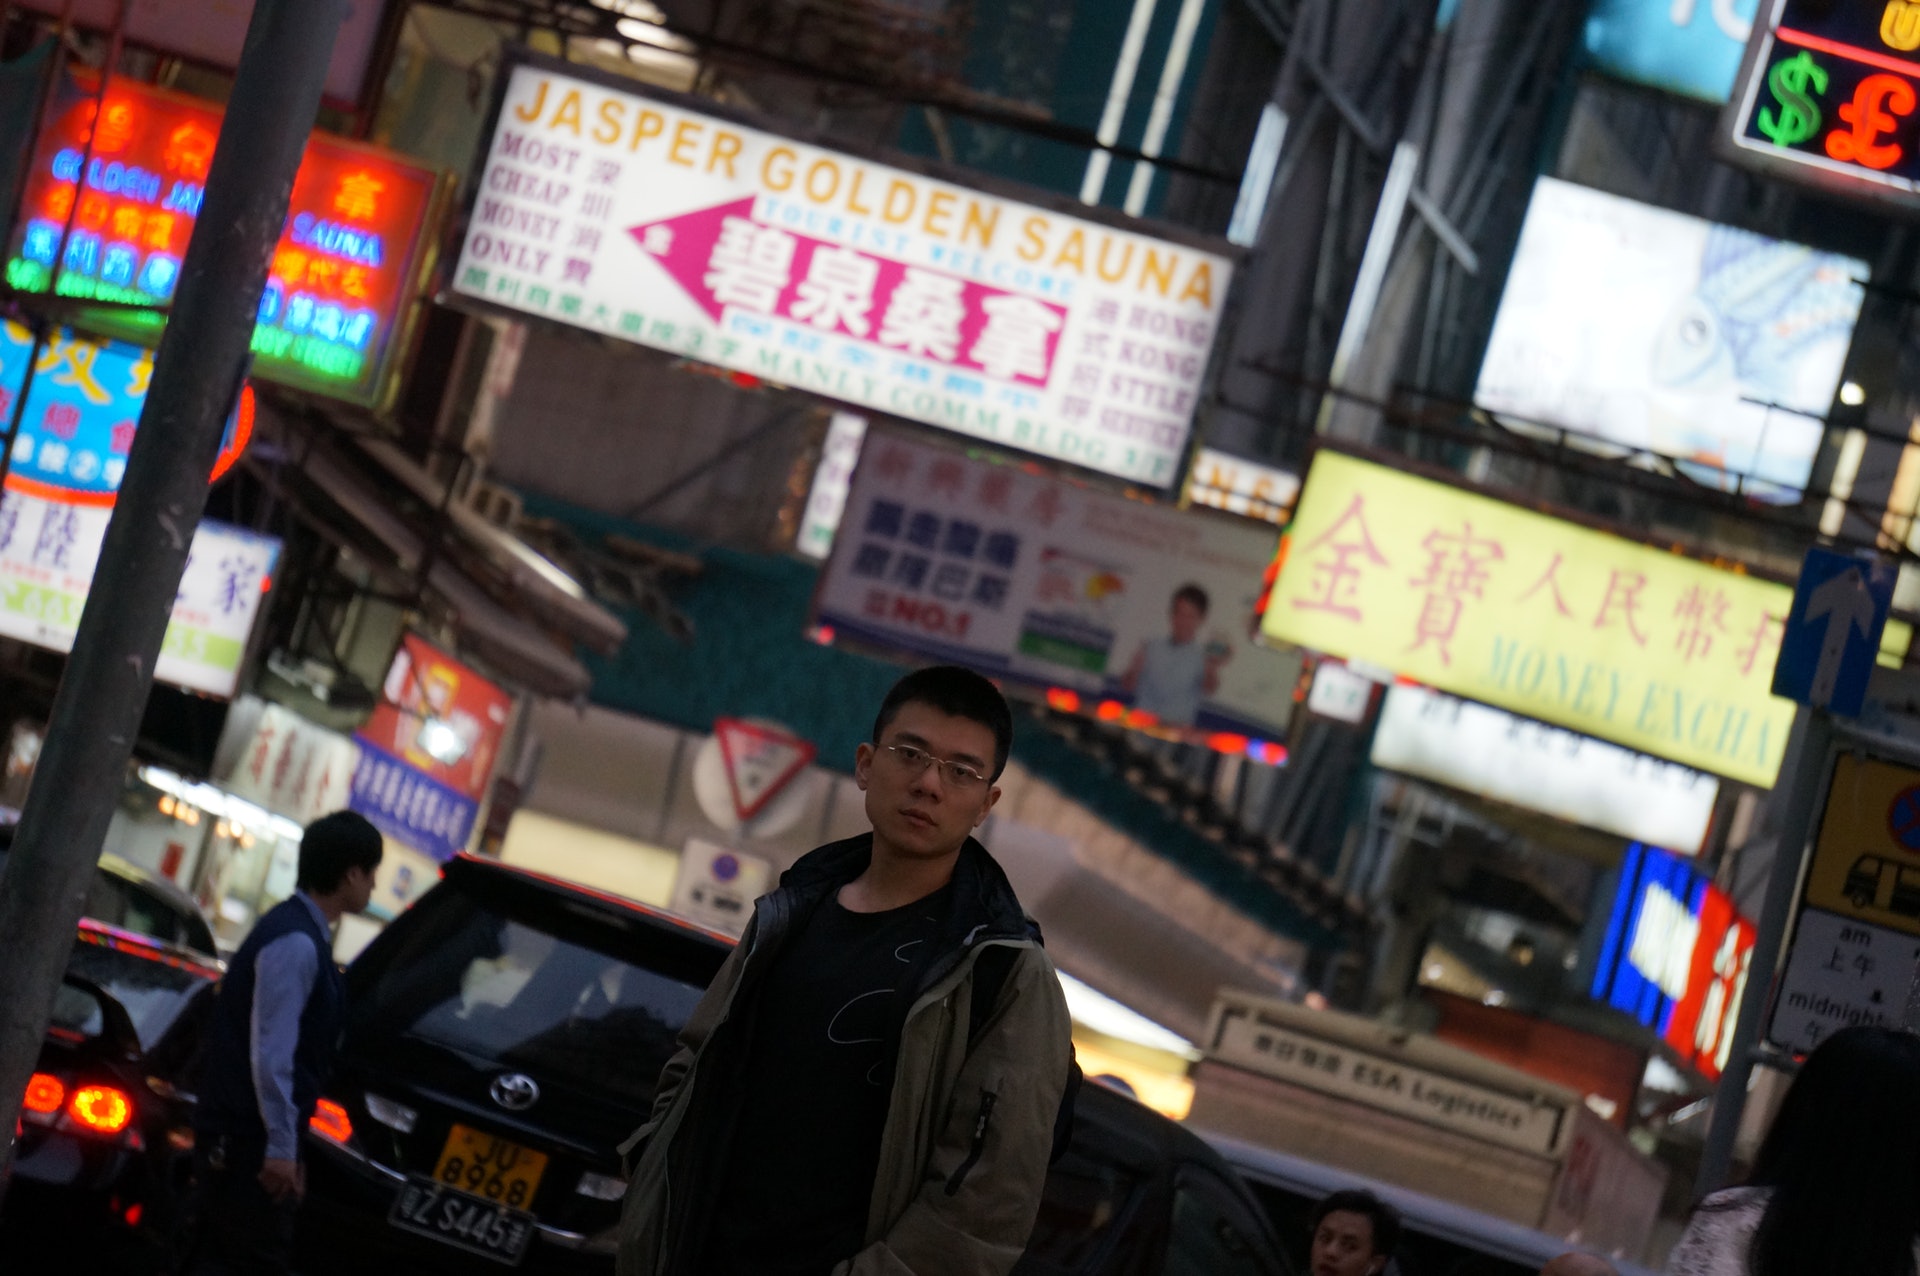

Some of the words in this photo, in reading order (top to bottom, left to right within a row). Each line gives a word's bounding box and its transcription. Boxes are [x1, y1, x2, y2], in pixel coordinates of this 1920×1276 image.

[501, 132, 581, 174] MOST
[488, 163, 571, 207] CHEAP
[514, 79, 744, 179] JASPER
[760, 146, 1002, 249] GOLDEN
[1014, 215, 1216, 311] SAUNA
[290, 211, 384, 267] SAUNA
[479, 199, 561, 239] MONEY
[469, 235, 551, 276] ONLY
[763, 198, 909, 255] TOURIST
[929, 239, 1077, 300] WELCOME
[703, 214, 1064, 380] 碧泉桑拿
[1128, 302, 1208, 346] HONG
[1117, 337, 1199, 381] KONG
[757, 346, 875, 398] MANLY
[890, 383, 1003, 434] COMM
[1012, 414, 1107, 464] BLDG
[1109, 372, 1194, 416] STYLE
[1485, 632, 1627, 724] MONEY
[1838, 926, 1872, 946] am
[1821, 946, 1877, 979] 上午
[1350, 1059, 1402, 1092] ESA
[469, 1136, 518, 1171] JU
[441, 1156, 531, 1206] 8968
